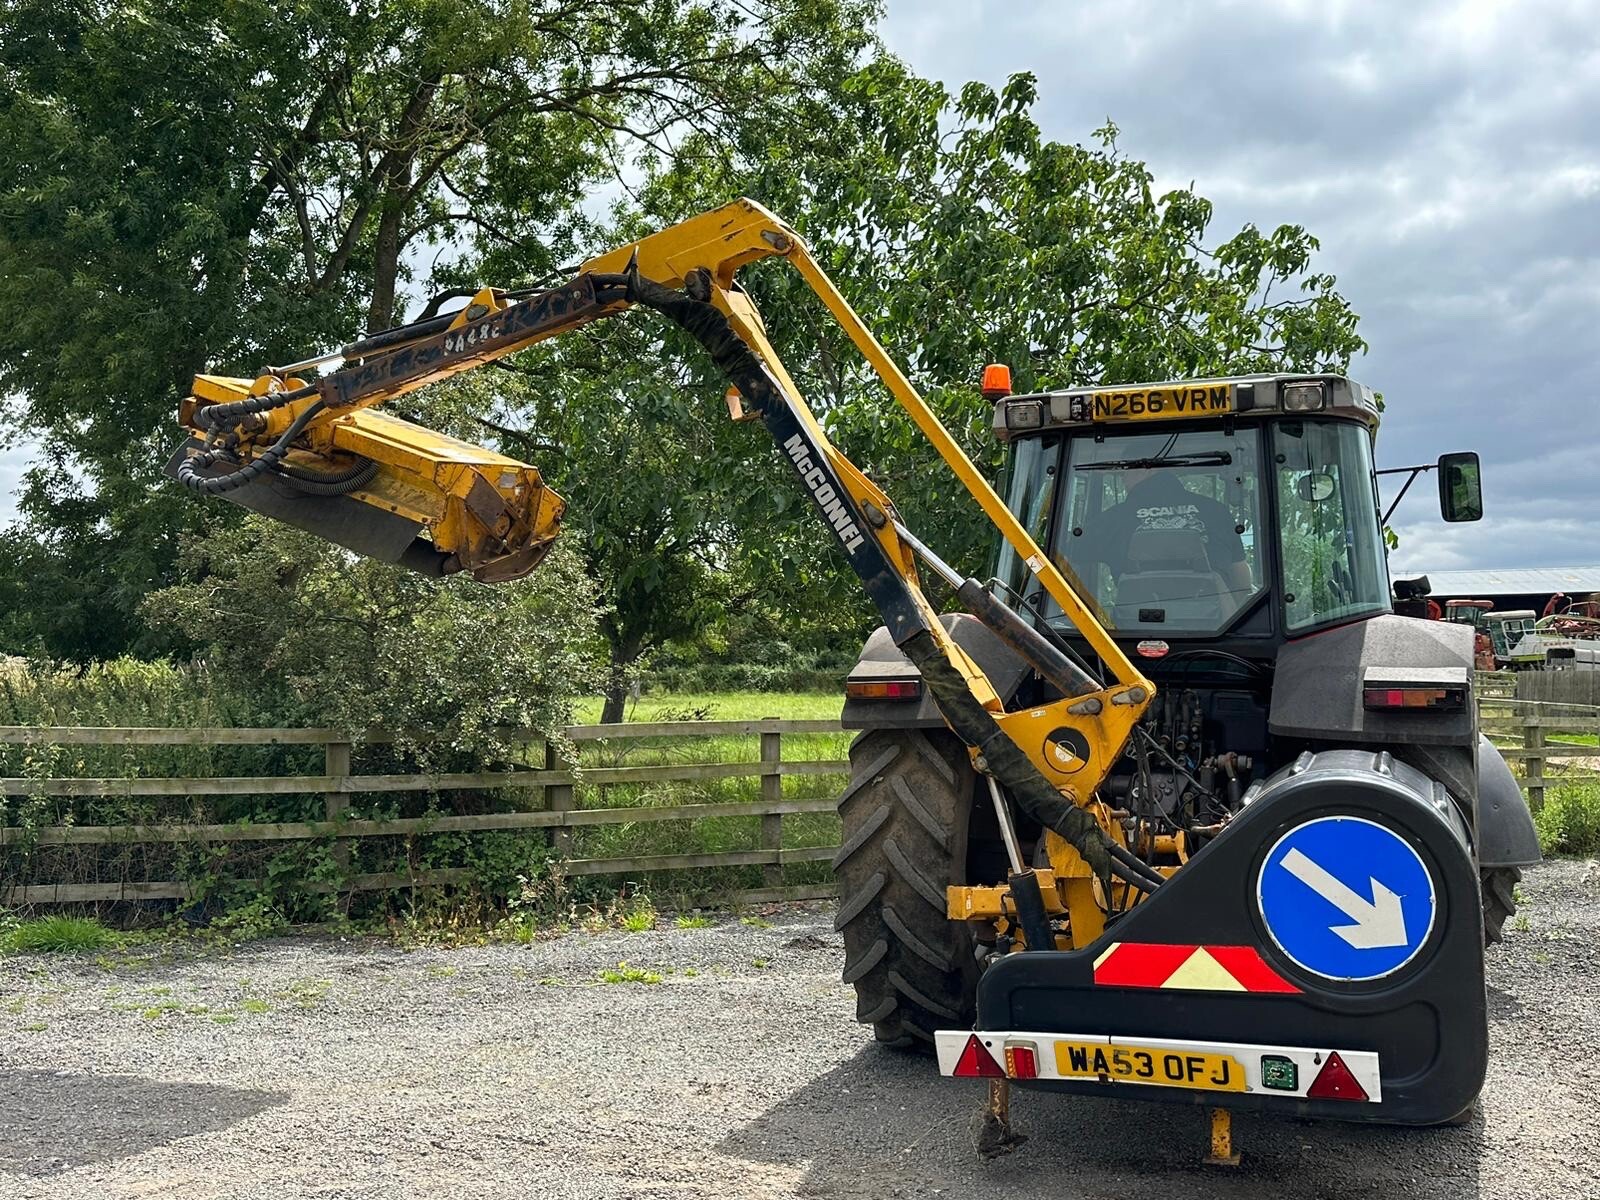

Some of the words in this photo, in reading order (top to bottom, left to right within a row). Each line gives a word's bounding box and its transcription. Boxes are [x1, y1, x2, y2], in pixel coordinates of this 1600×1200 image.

[1095, 391, 1163, 416] N266
[1172, 387, 1227, 412] VRM
[1136, 505, 1199, 518] SCANIA
[1067, 1046, 1154, 1078] WA53
[1163, 1054, 1230, 1086] OFJ
